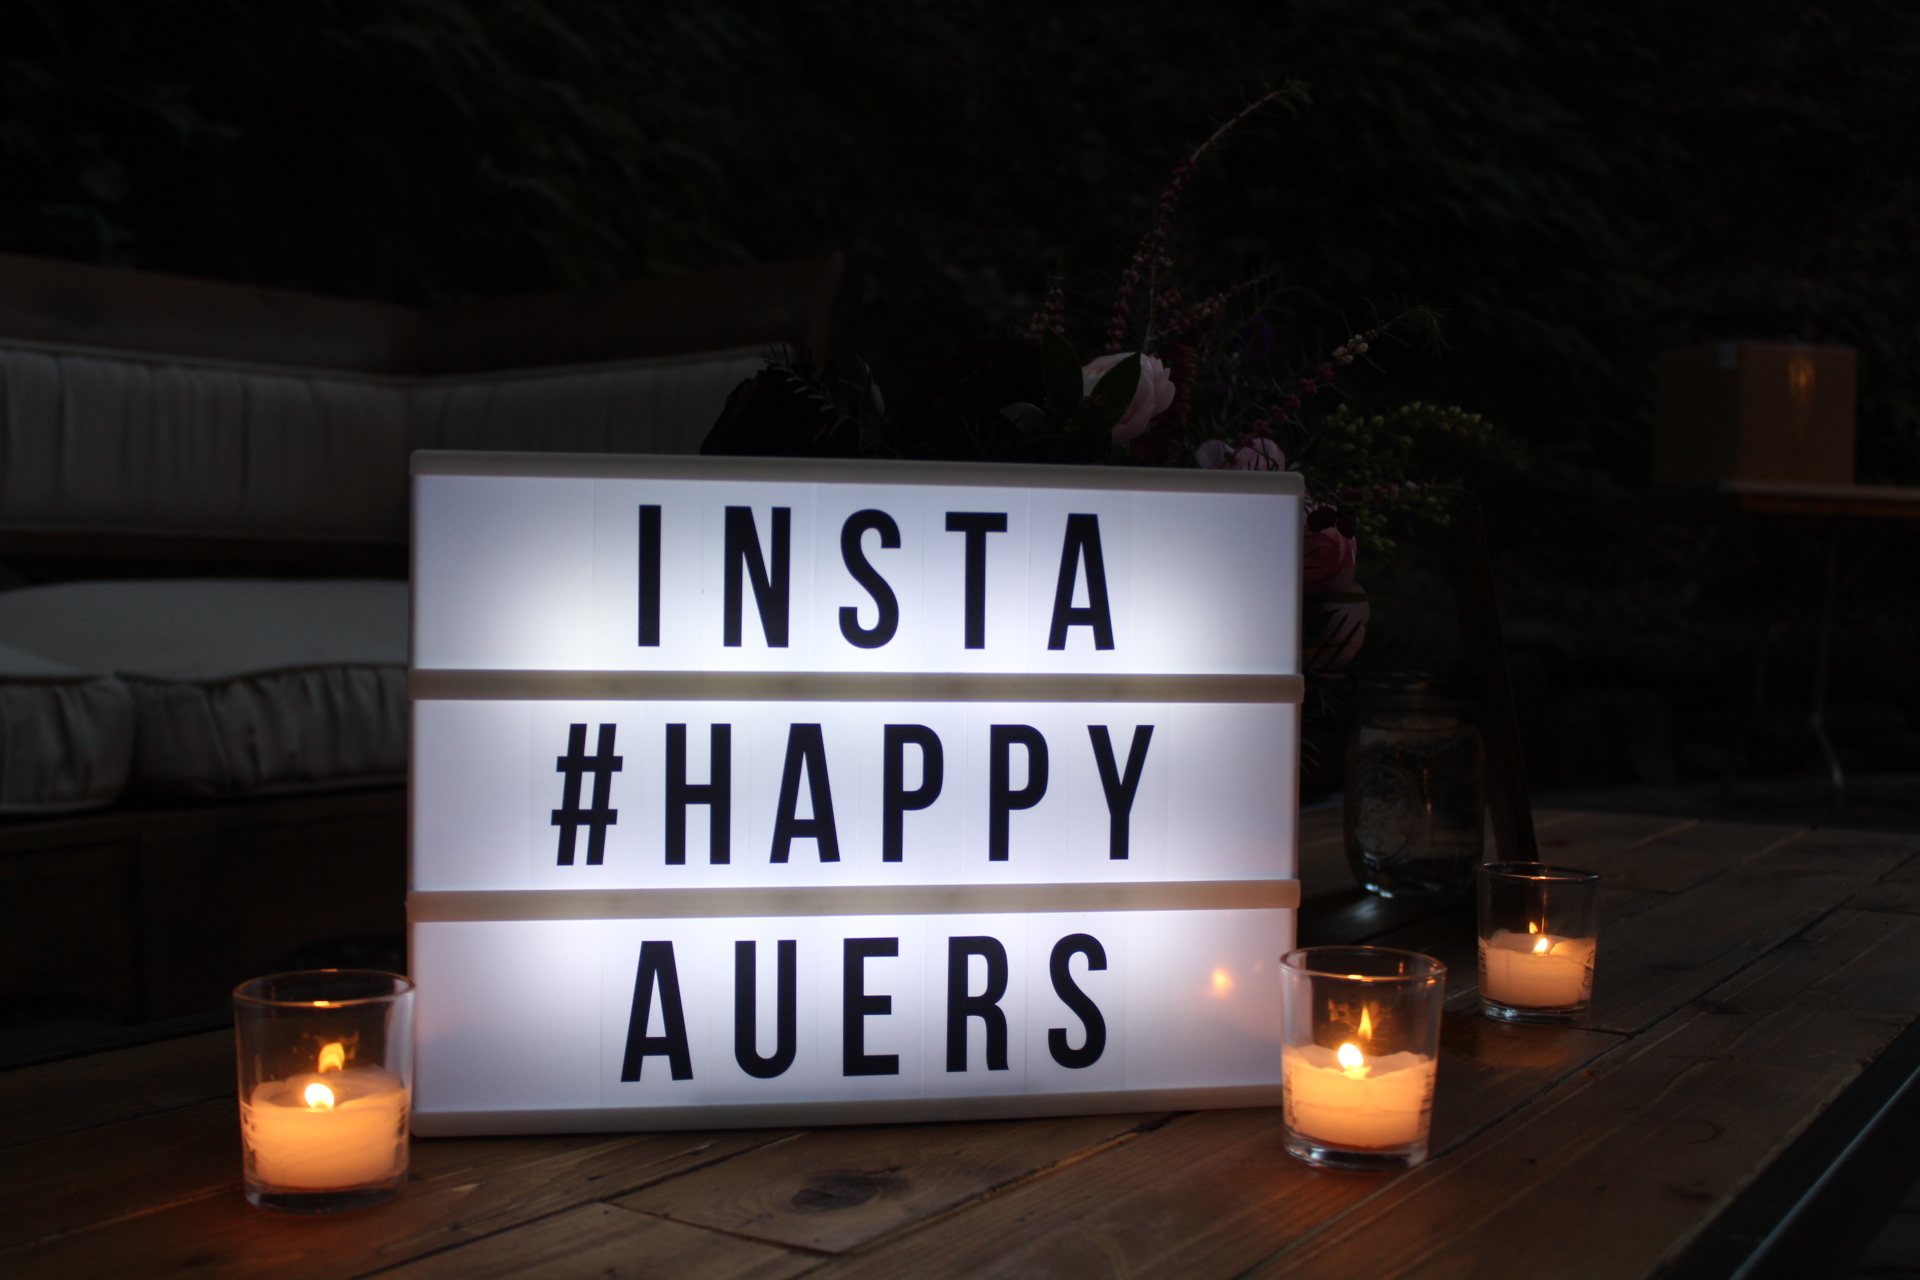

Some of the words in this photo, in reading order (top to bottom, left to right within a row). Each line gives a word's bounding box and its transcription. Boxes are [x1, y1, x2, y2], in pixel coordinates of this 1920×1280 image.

[638, 504, 1115, 651] INSTA
[550, 723, 1155, 866] #HAPPY
[620, 933, 1108, 1083] AUERS
